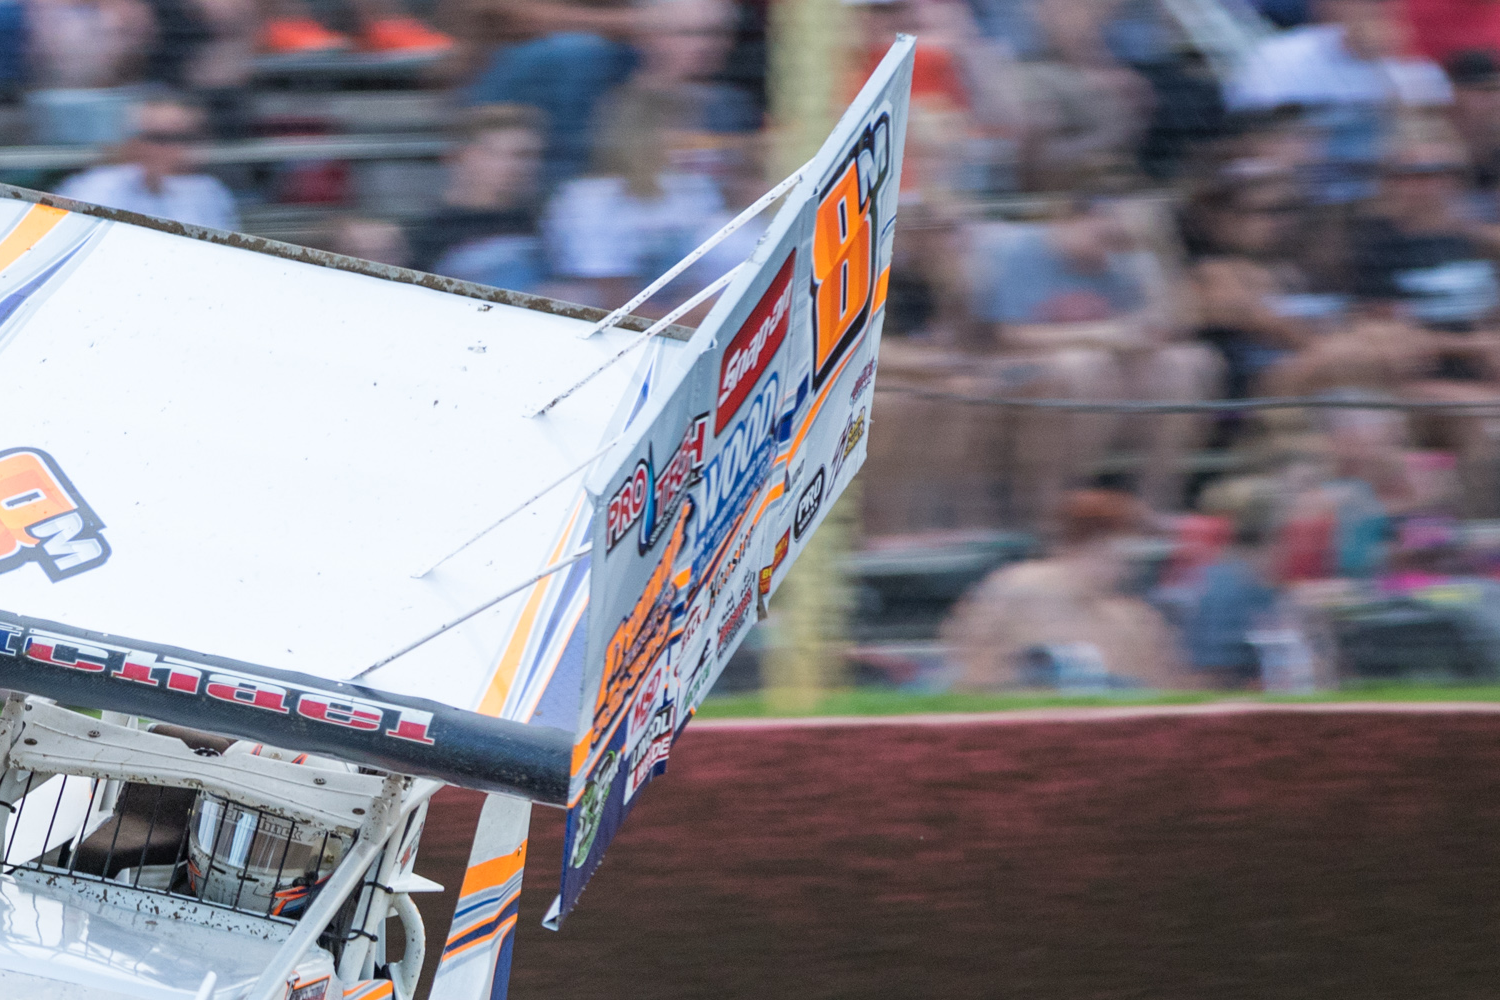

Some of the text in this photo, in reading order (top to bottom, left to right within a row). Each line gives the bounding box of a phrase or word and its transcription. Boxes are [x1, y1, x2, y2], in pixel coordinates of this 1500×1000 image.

[719, 276, 793, 407] Snap-on
[697, 376, 778, 536] WOOD
[797, 471, 822, 523] PRO
[607, 462, 648, 550] PRO
[631, 667, 662, 735] MSD
